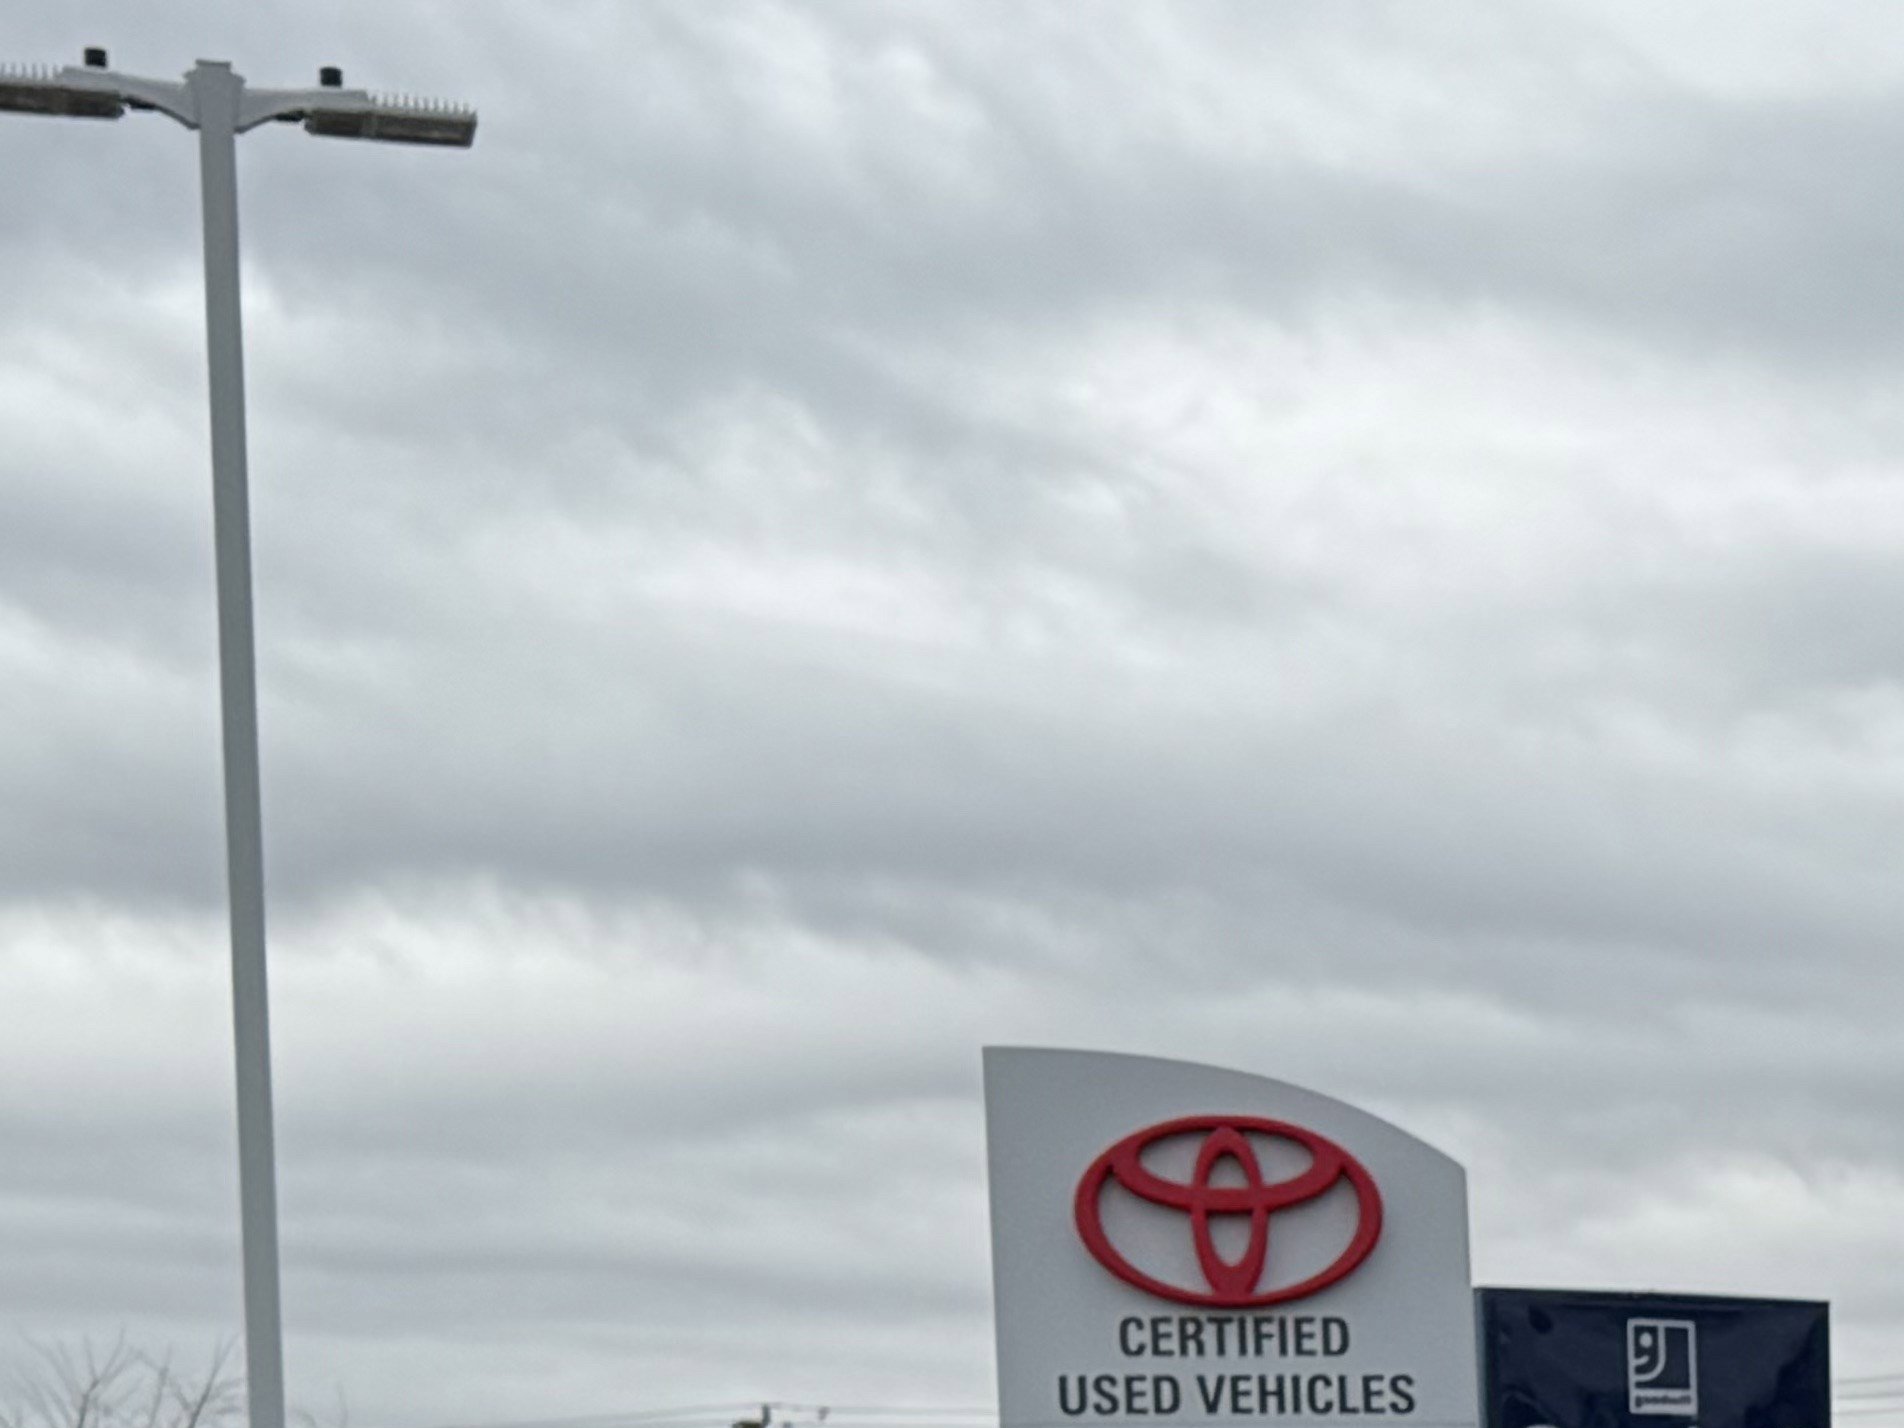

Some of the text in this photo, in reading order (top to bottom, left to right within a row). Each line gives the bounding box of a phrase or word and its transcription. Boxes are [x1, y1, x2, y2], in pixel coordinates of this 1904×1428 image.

[1119, 1315, 1351, 1358] CERTIFIED
[1058, 1373, 1416, 1416] USED VEHICLES
